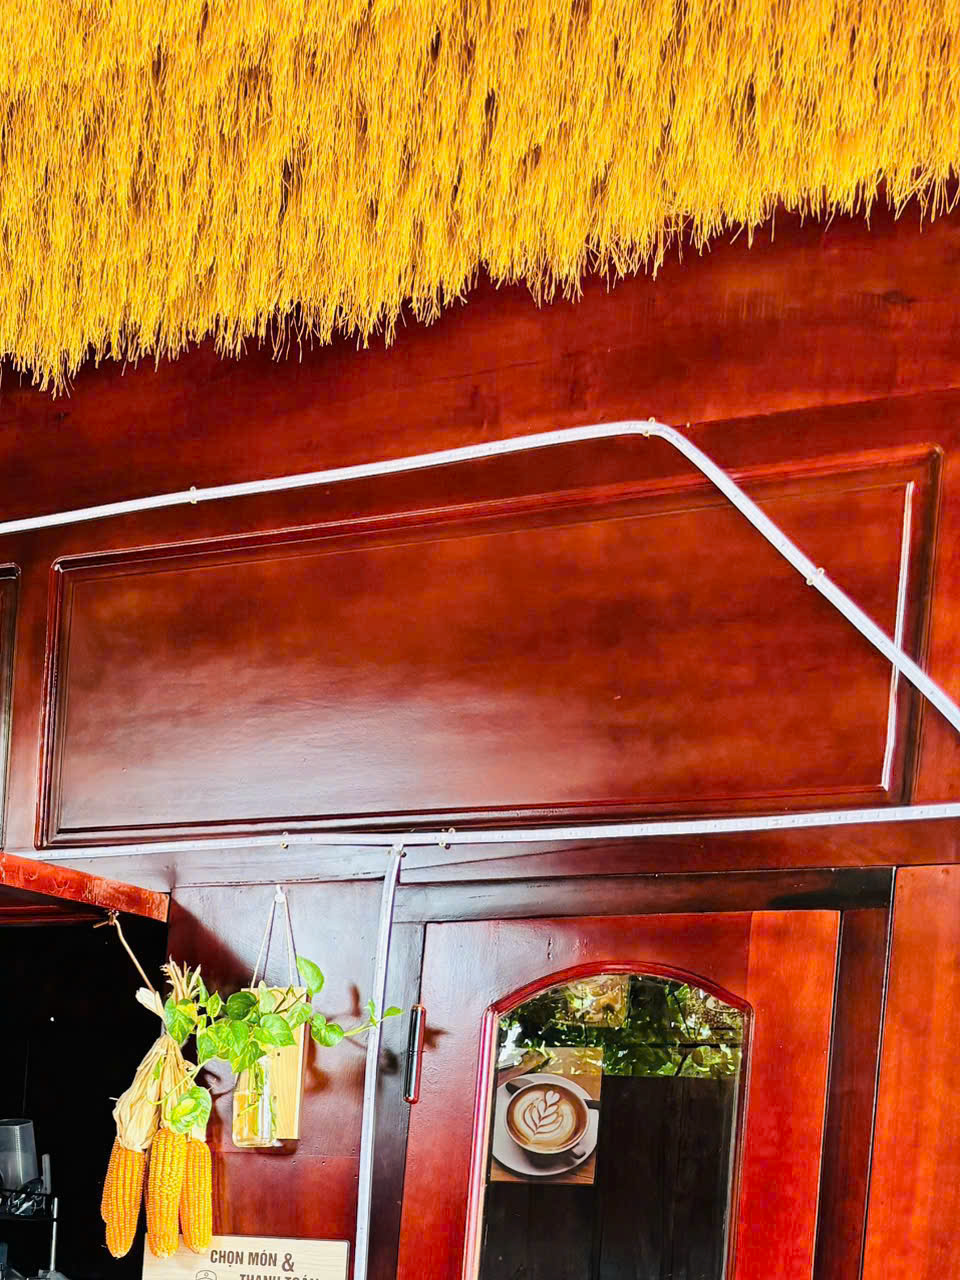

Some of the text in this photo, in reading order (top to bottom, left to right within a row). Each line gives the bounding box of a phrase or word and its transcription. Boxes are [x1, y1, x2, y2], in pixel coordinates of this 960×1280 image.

[210, 1249, 294, 1272] CHỌN MÓN &
